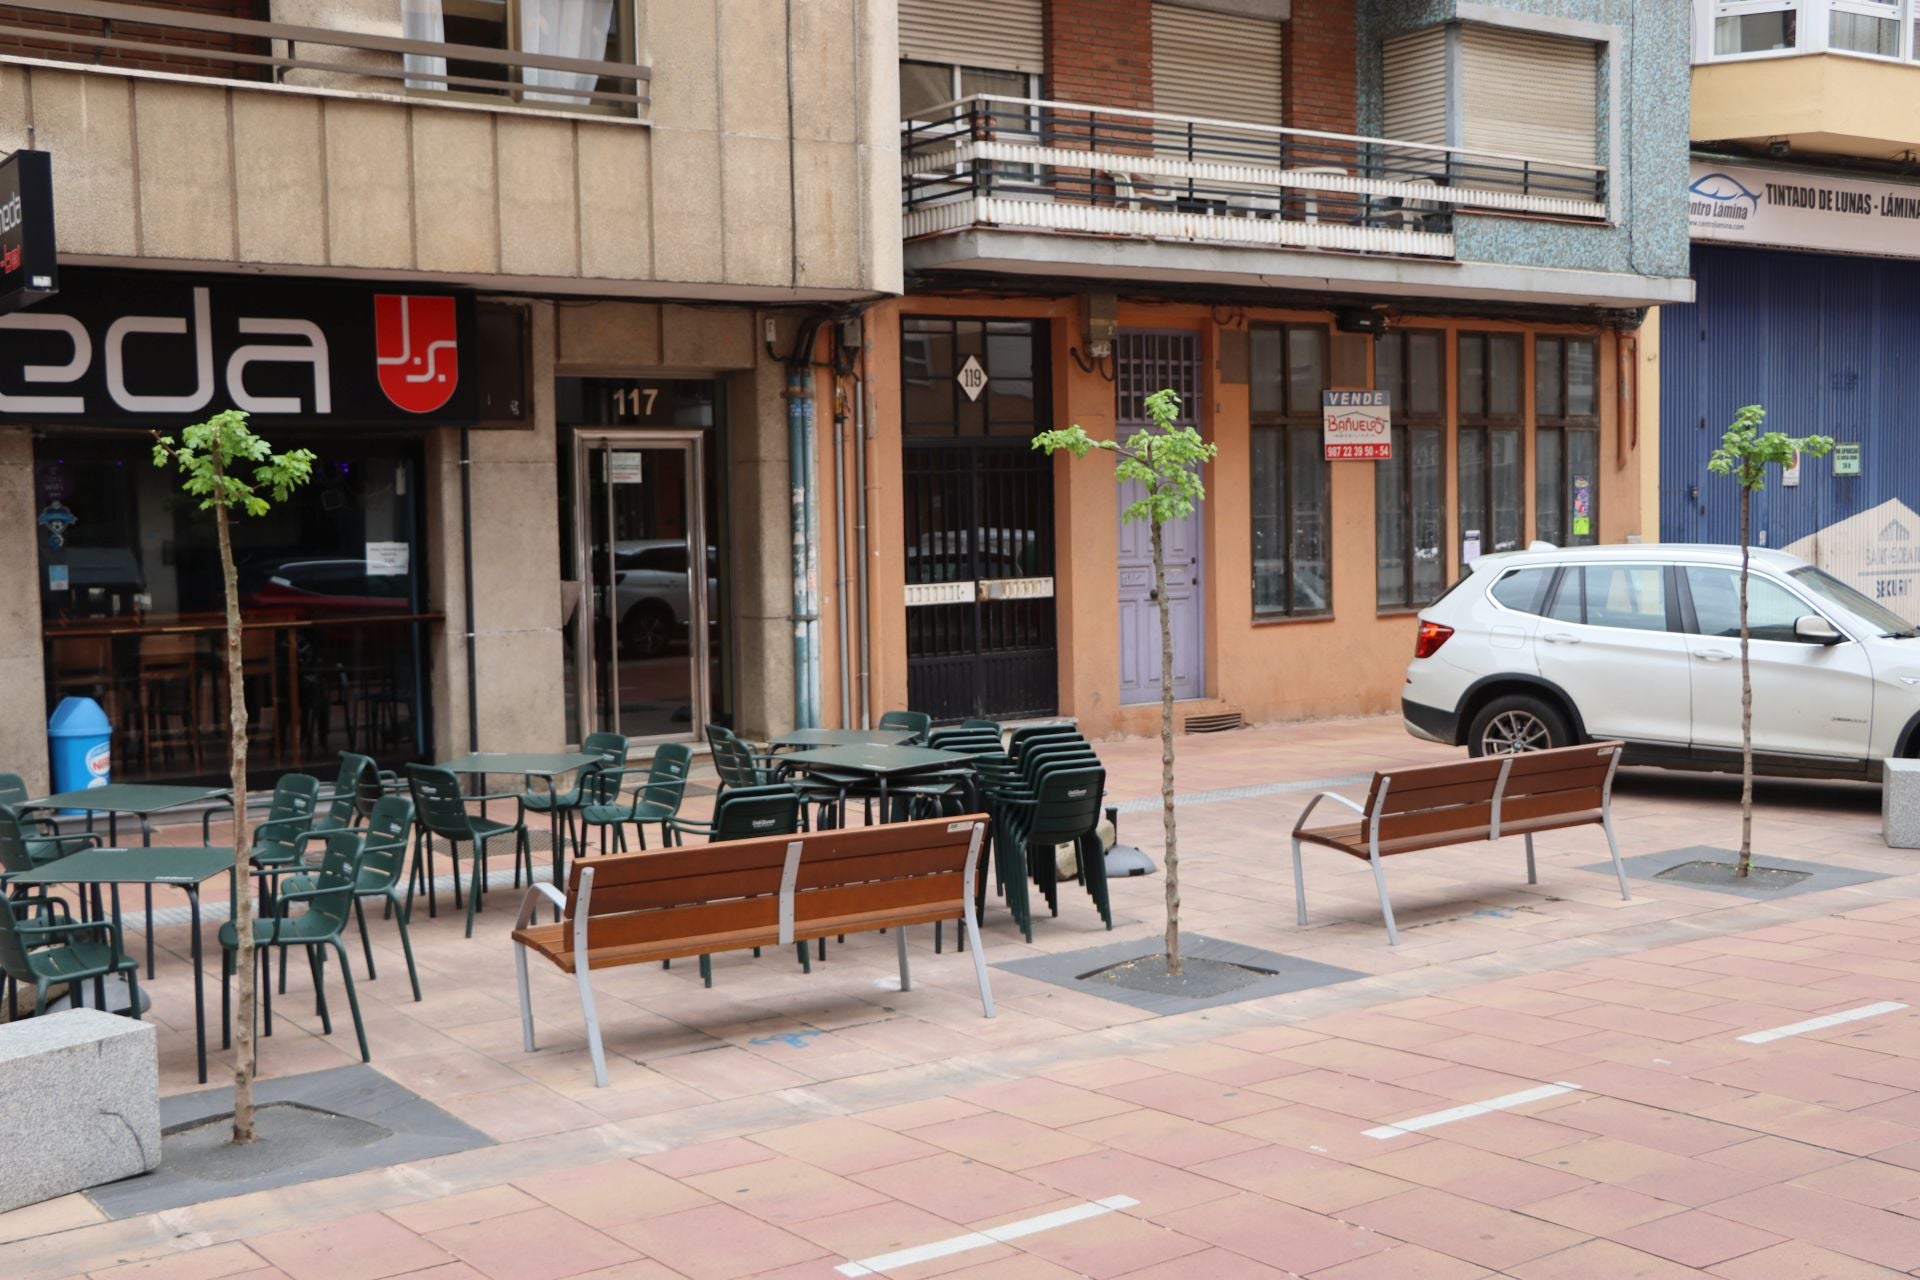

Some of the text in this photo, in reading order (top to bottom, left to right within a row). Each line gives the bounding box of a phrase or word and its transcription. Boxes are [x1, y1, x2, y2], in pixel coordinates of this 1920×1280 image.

[1765, 183, 1815, 209] TINTADO
[1818, 189, 1833, 211] DE
[1835, 190, 1871, 215] LUNAS
[1713, 200, 1748, 220] Lámina
[964, 368, 982, 388] 119
[613, 388, 659, 416] 117
[1329, 392, 1383, 405] VENDE
[1327, 446, 1341, 457] 987
[1343, 446, 1353, 457] 22
[1353, 446, 1363, 457] 39
[1380, 445, 1389, 456] 54
